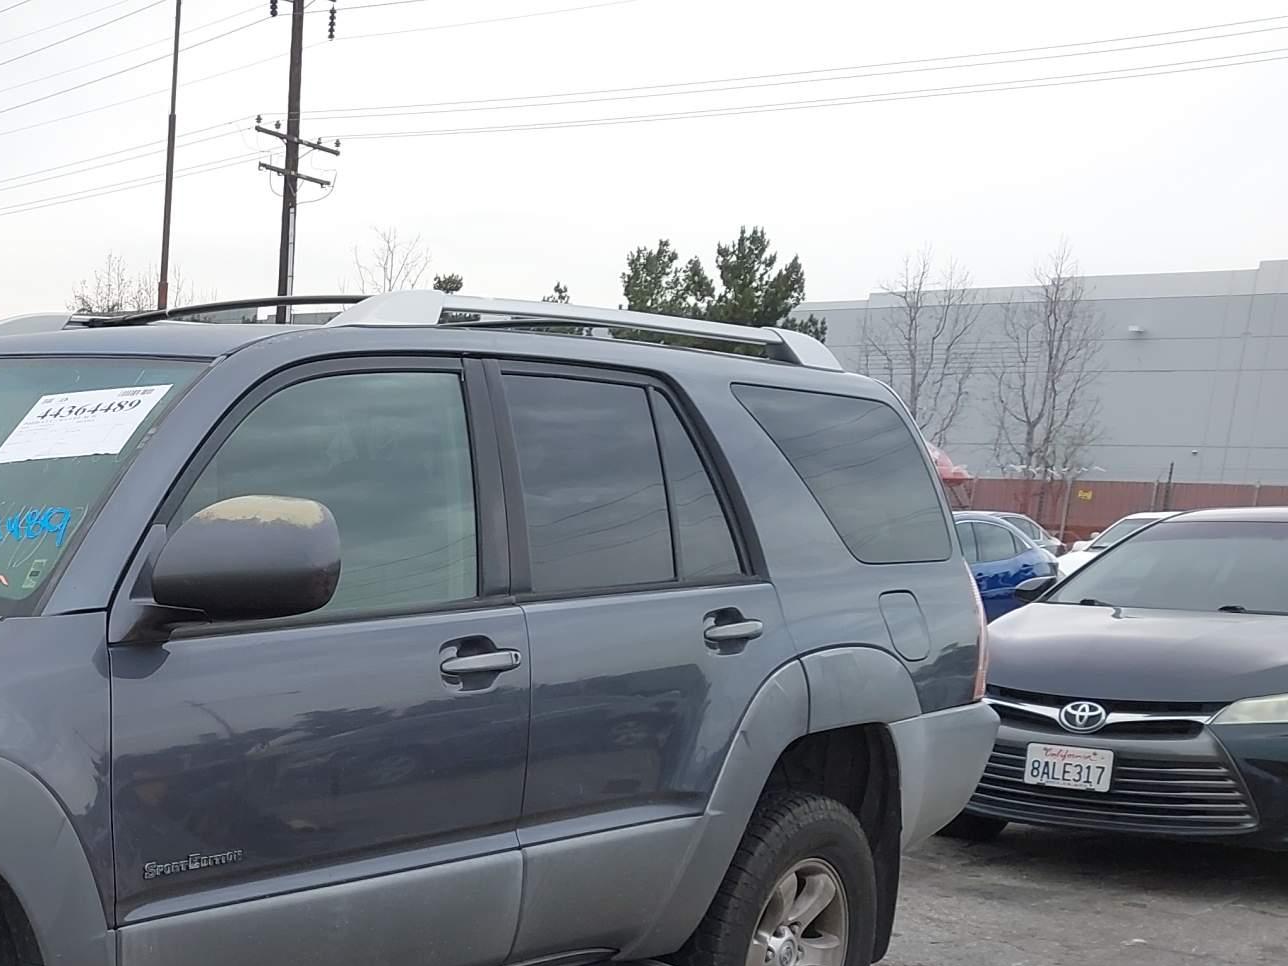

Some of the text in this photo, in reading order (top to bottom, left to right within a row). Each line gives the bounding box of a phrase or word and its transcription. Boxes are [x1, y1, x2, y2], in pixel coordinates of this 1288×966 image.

[36, 398, 142, 420] 44364489
[1043, 747, 1099, 762] California
[1030, 759, 1106, 785] 8ALE317
